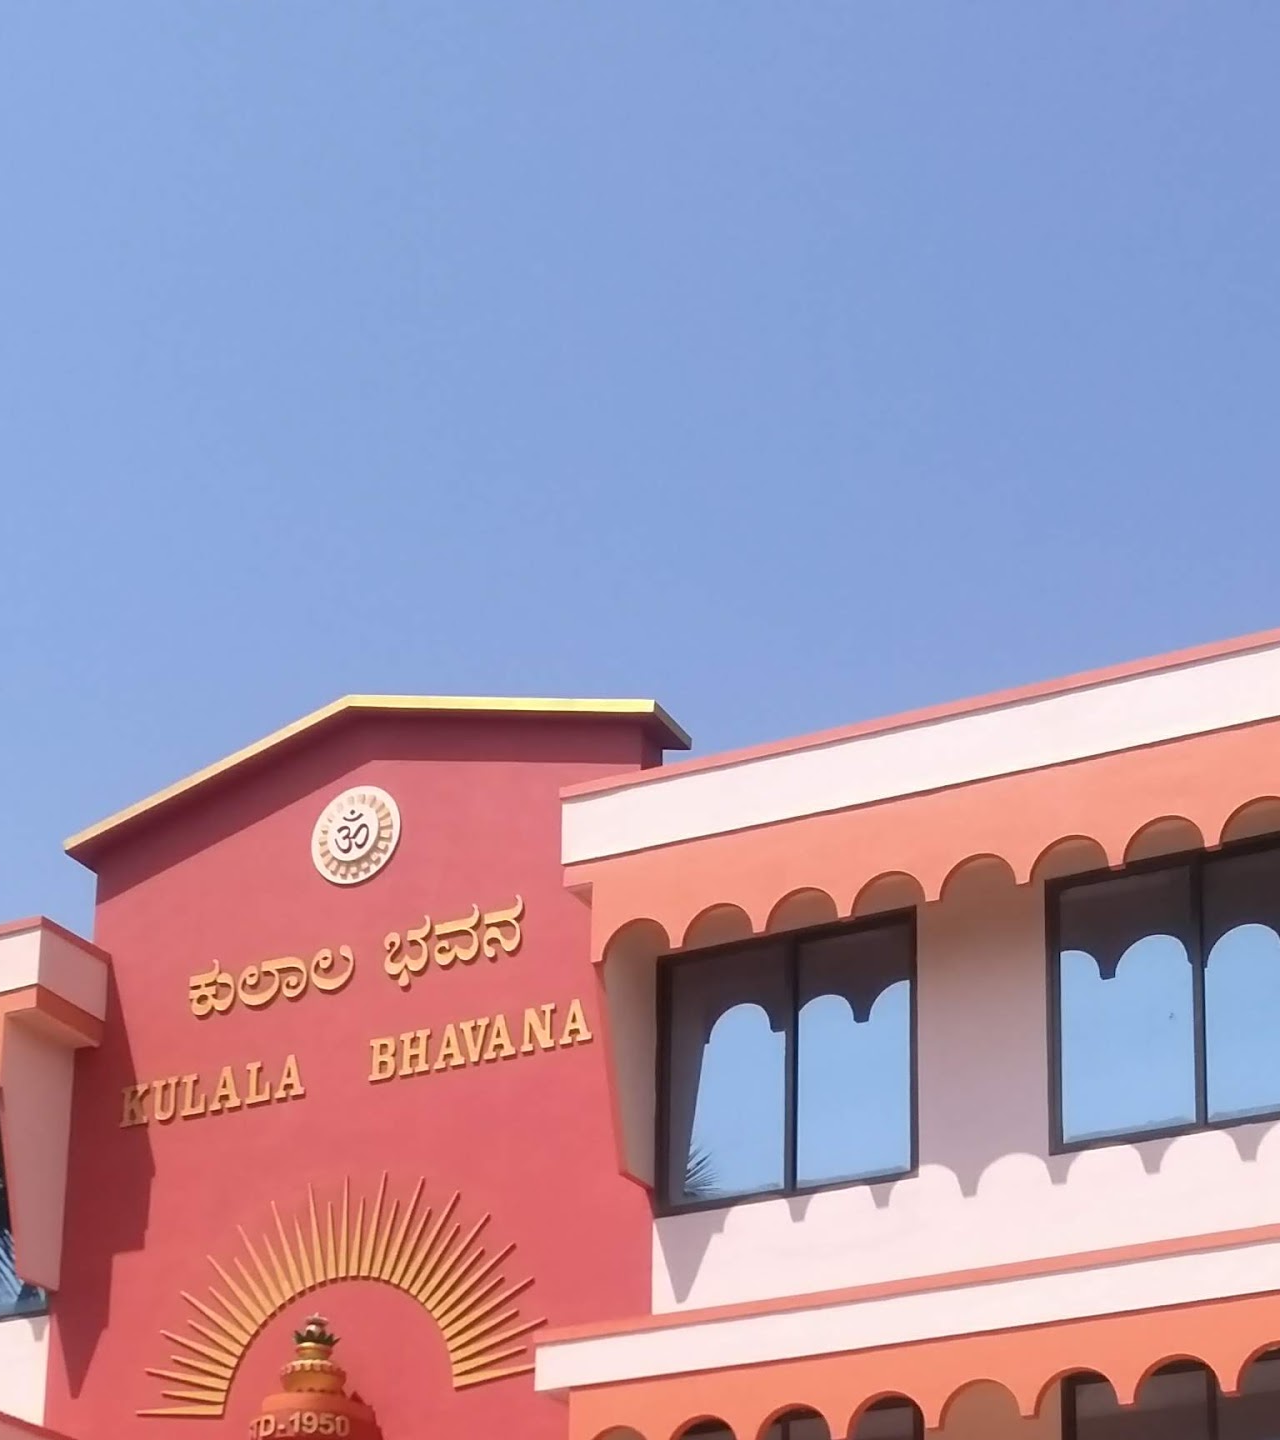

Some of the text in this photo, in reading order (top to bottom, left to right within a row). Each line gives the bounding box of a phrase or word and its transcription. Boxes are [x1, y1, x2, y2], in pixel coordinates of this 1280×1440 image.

[188, 894, 524, 1016] ಕುಲಾಲ ಭವನ
[120, 998, 593, 1128] KULALA BHAVANA
